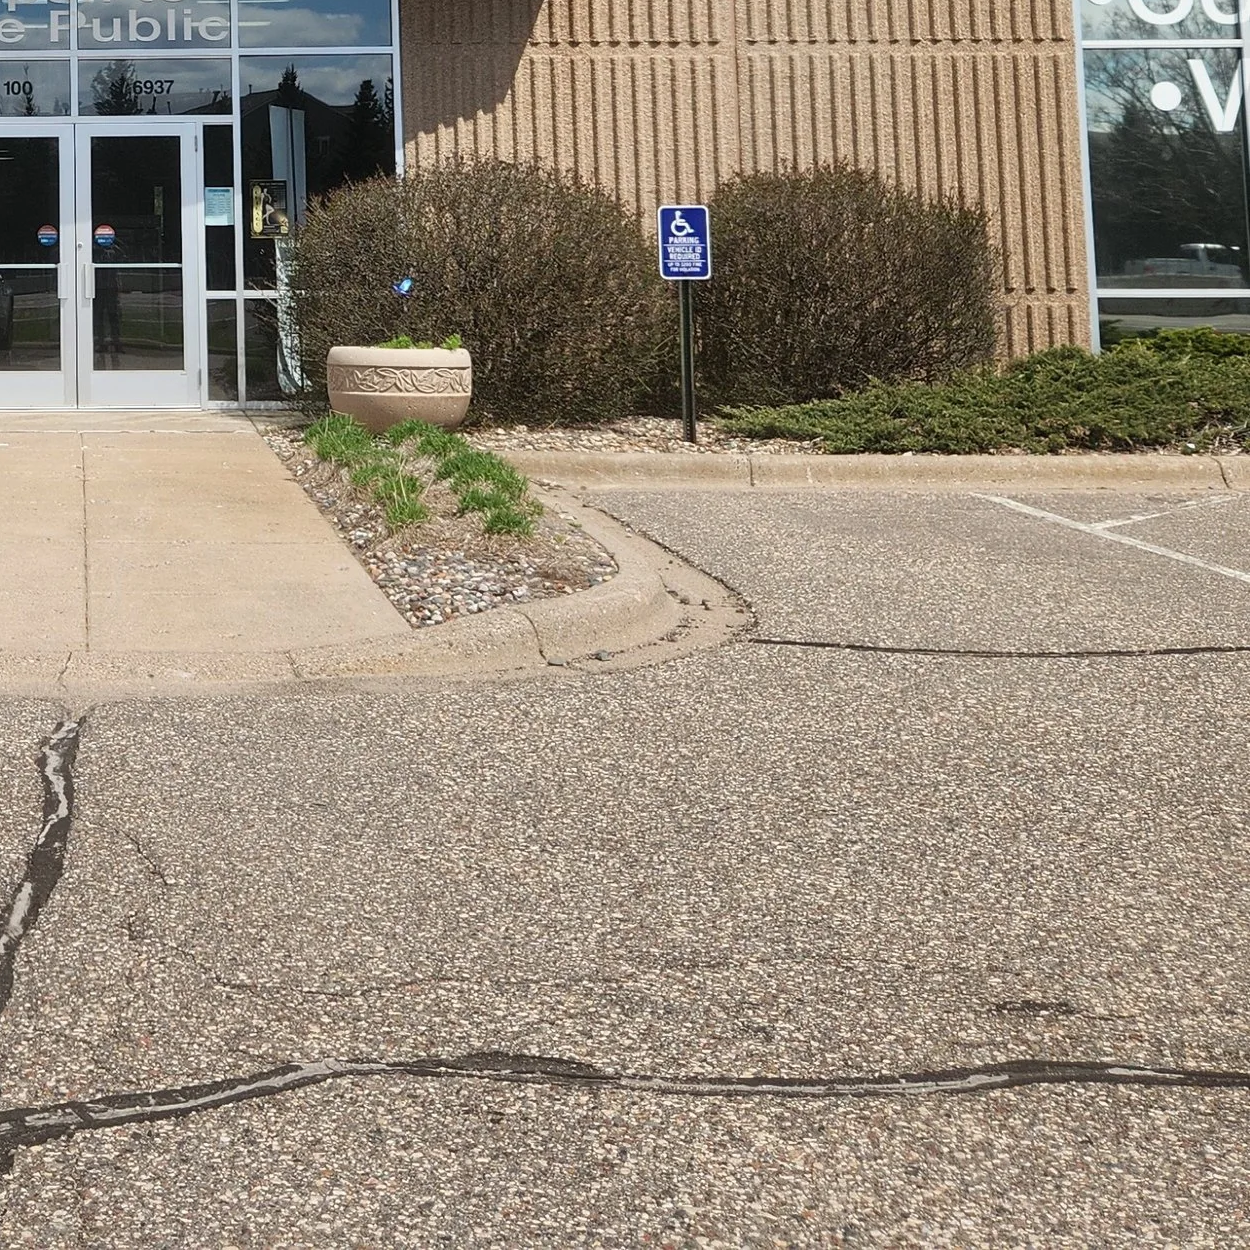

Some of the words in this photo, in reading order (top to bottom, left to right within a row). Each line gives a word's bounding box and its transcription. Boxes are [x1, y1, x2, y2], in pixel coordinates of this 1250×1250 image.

[50, 8, 230, 44] Public
[3, 81, 34, 96] 100
[132, 80, 175, 96] 6937
[668, 236, 700, 244] PARKING
